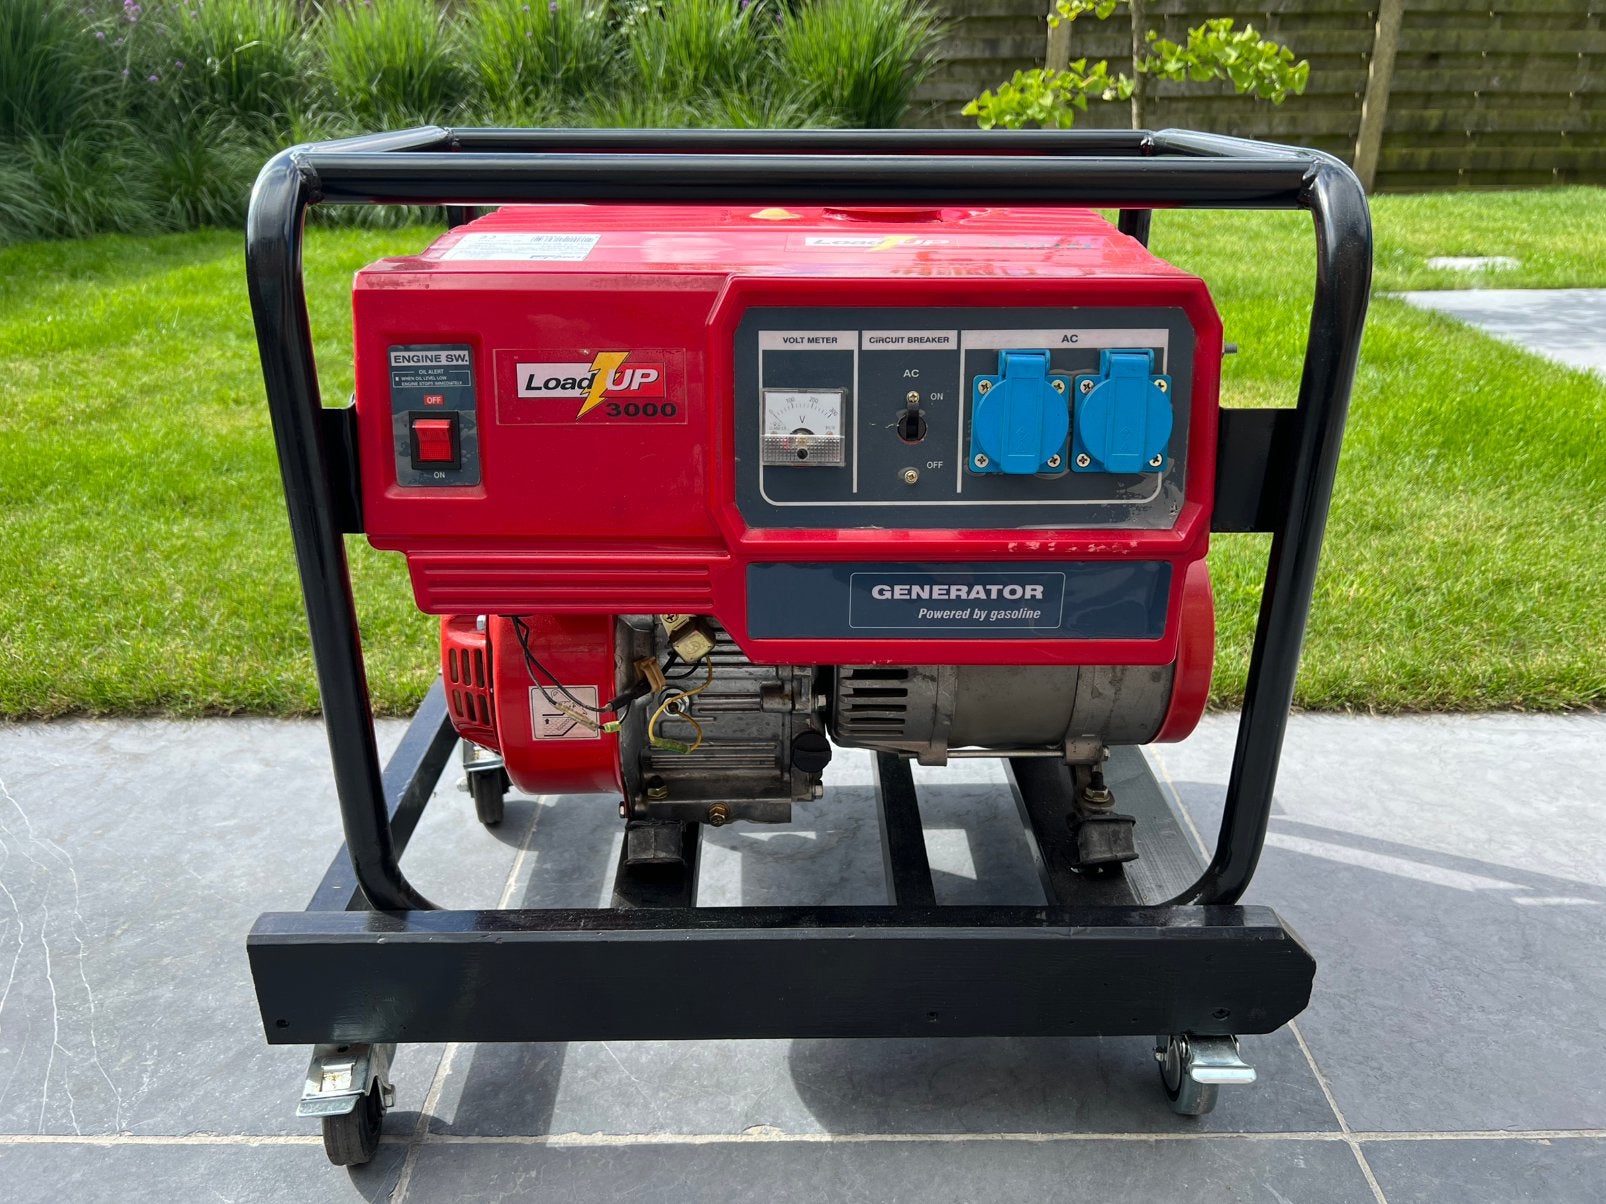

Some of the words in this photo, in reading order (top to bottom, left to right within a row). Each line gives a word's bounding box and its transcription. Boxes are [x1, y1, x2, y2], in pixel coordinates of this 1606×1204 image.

[782, 336, 805, 344] VOLT
[807, 336, 838, 344] METER
[869, 336, 906, 344] CIRCUIT
[907, 336, 950, 344] BREAKER
[1061, 334, 1079, 343] AC
[393, 354, 442, 364] ENGINE
[445, 353, 468, 363] SW.
[903, 369, 920, 378] AC
[525, 372, 596, 391] Load
[604, 368, 659, 391] UP
[426, 396, 442, 404] OFF
[606, 402, 678, 418] 3000
[799, 415, 806, 424] V
[926, 461, 944, 469] OFF
[433, 471, 446, 479] ON
[871, 584, 1045, 600] GENERATOR
[918, 607, 971, 619] Powered
[972, 607, 987, 621] by
[990, 607, 1041, 621] gasoline
